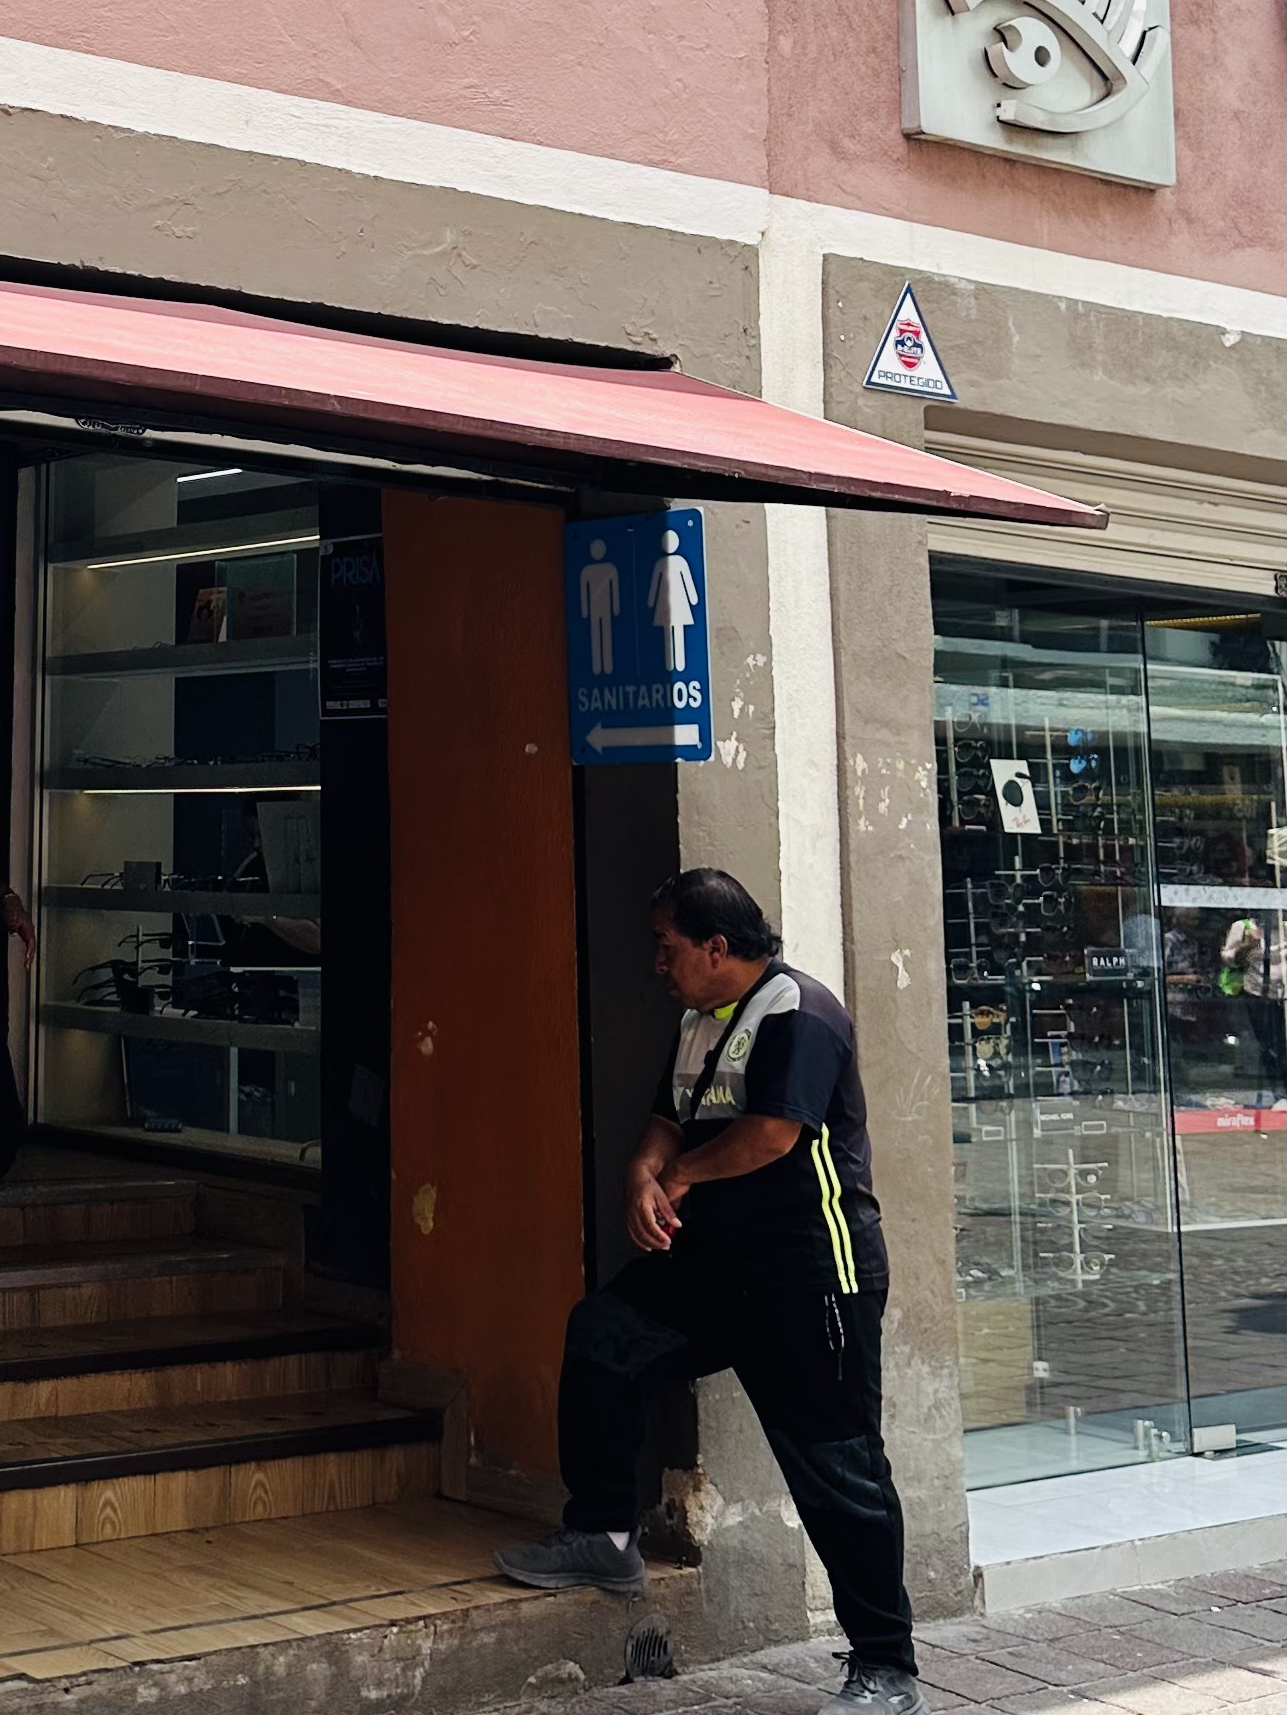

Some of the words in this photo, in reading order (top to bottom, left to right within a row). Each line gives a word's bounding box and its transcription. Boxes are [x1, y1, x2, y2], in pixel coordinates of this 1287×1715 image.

[877, 370, 942, 390] PROTEGIDO
[577, 680, 702, 712] SANITARIOS
[1092, 956, 1125, 967] RALPH
